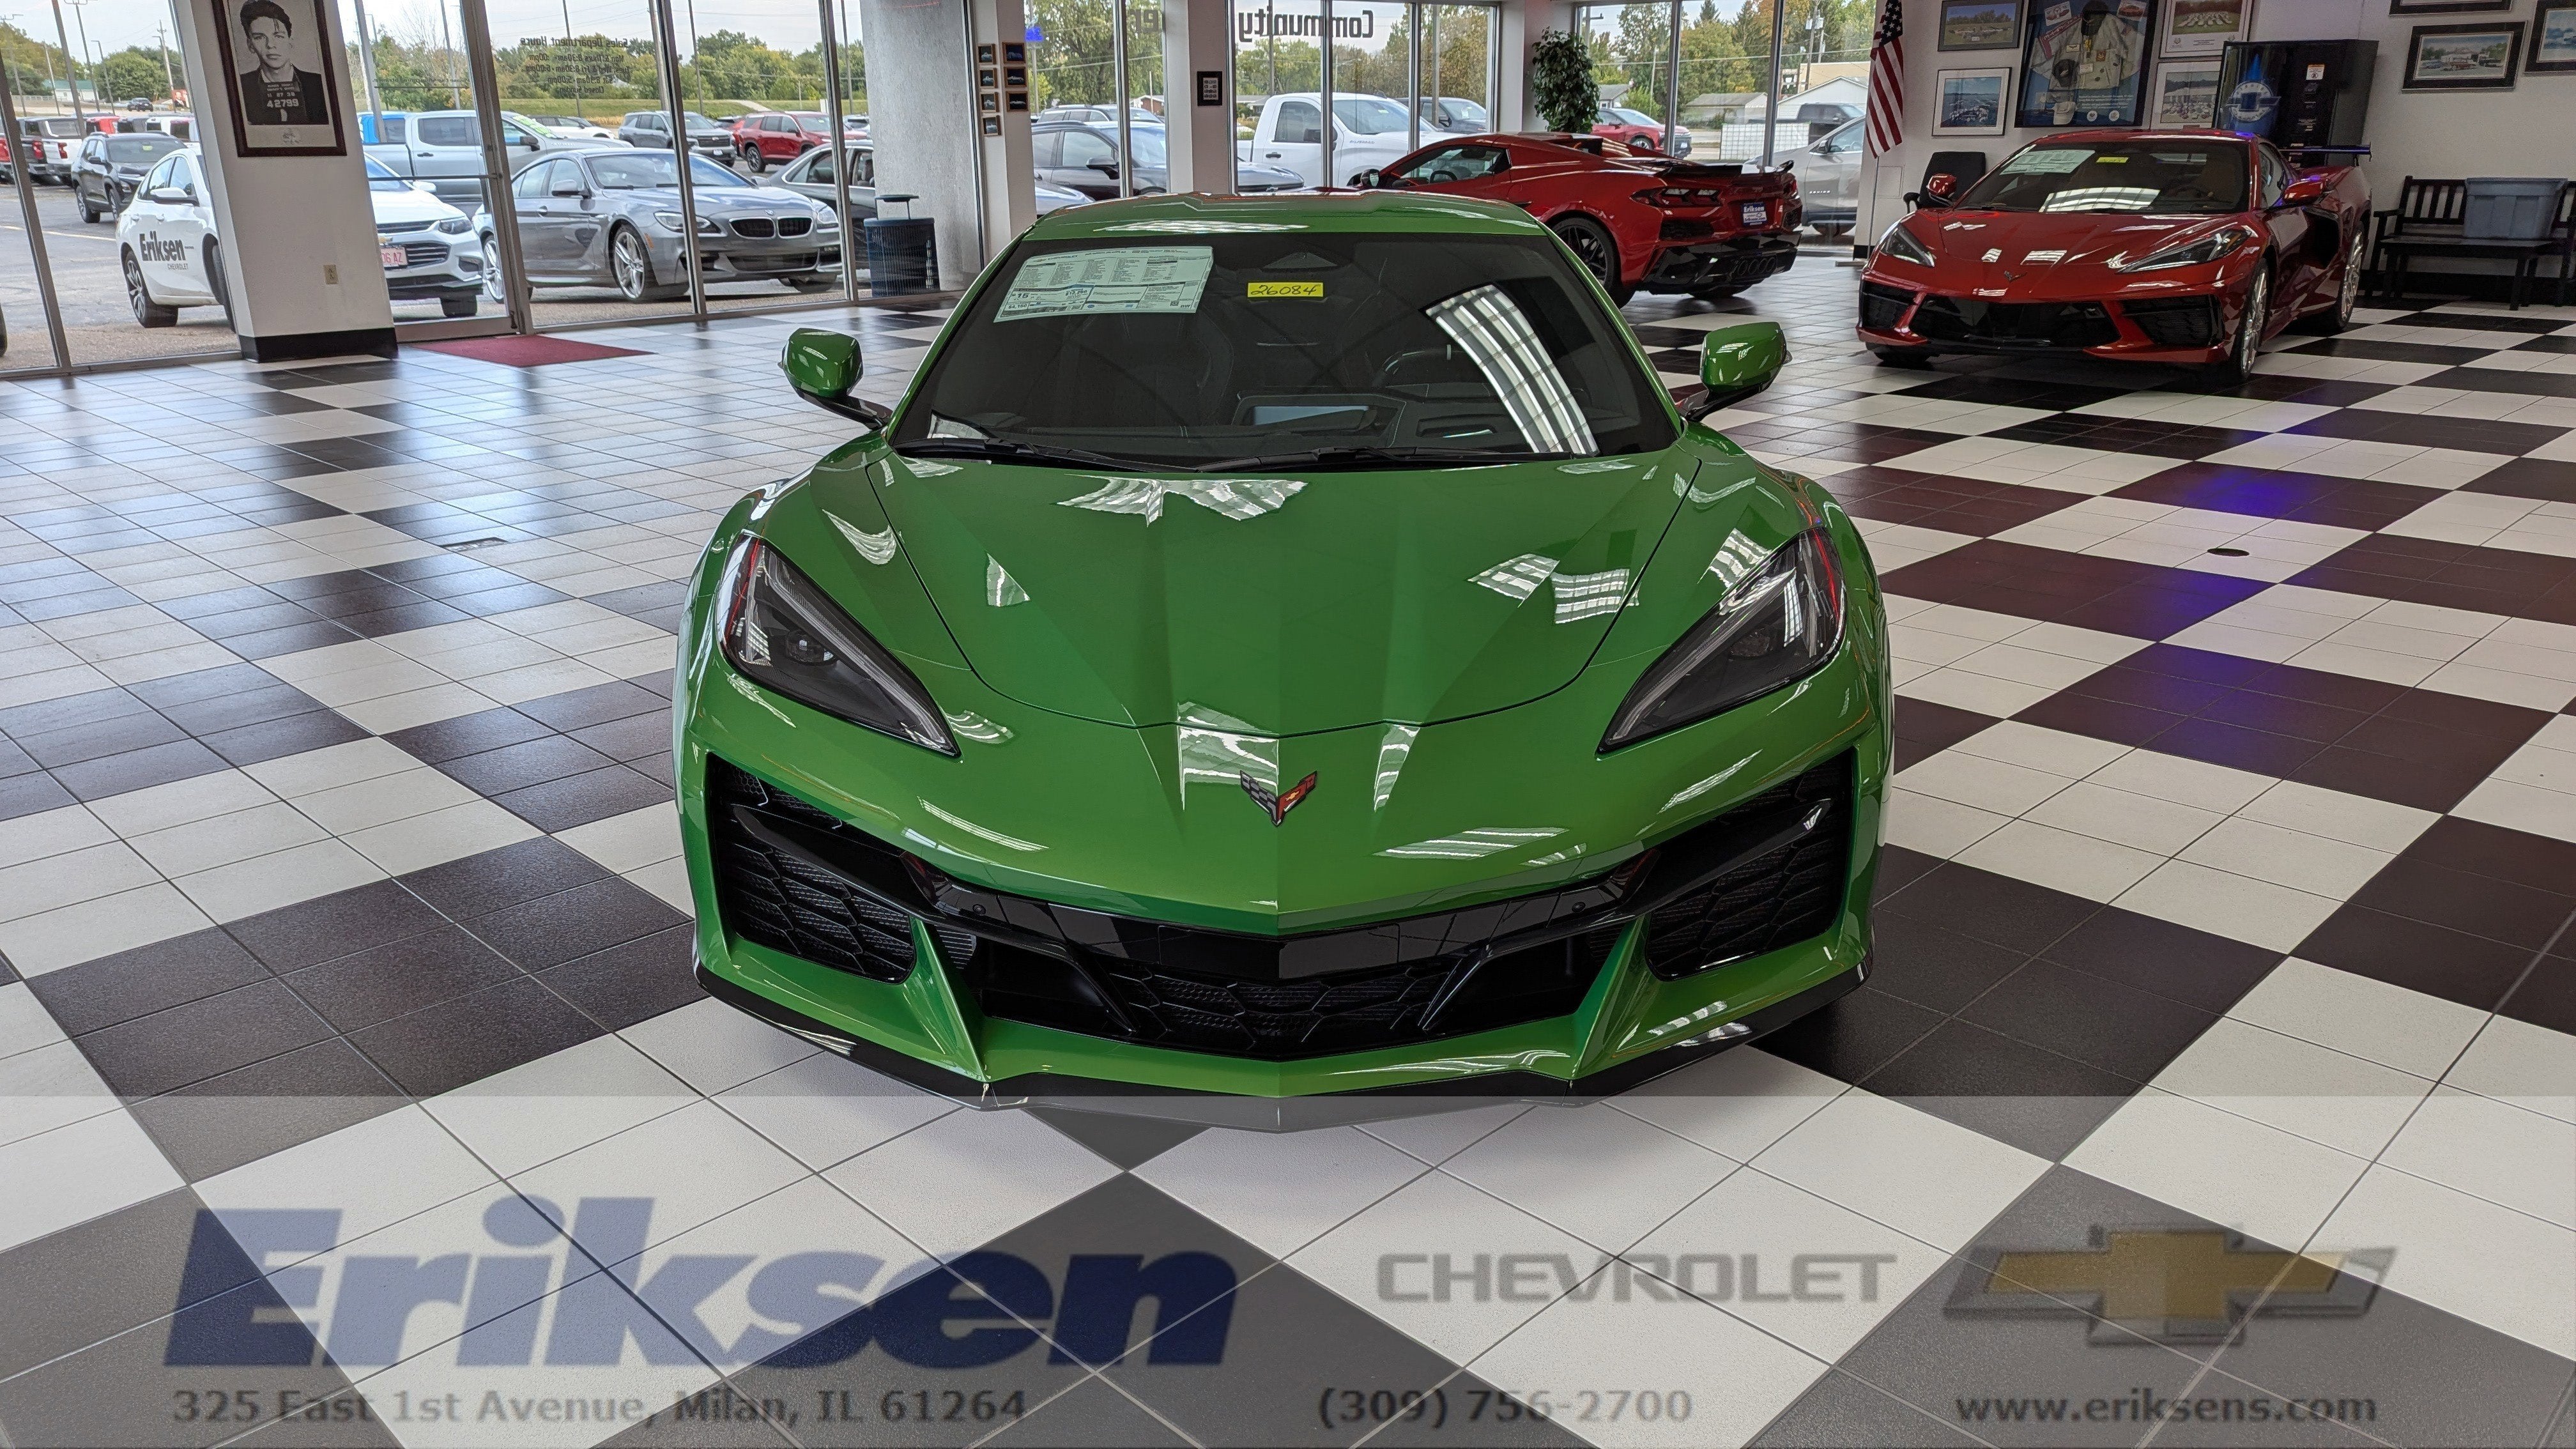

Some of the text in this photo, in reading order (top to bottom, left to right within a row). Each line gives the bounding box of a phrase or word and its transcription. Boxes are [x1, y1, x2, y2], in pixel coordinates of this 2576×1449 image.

[266, 98, 299, 108] 42799
[139, 230, 186, 261] Eriksen
[1250, 284, 1321, 296] 26084
